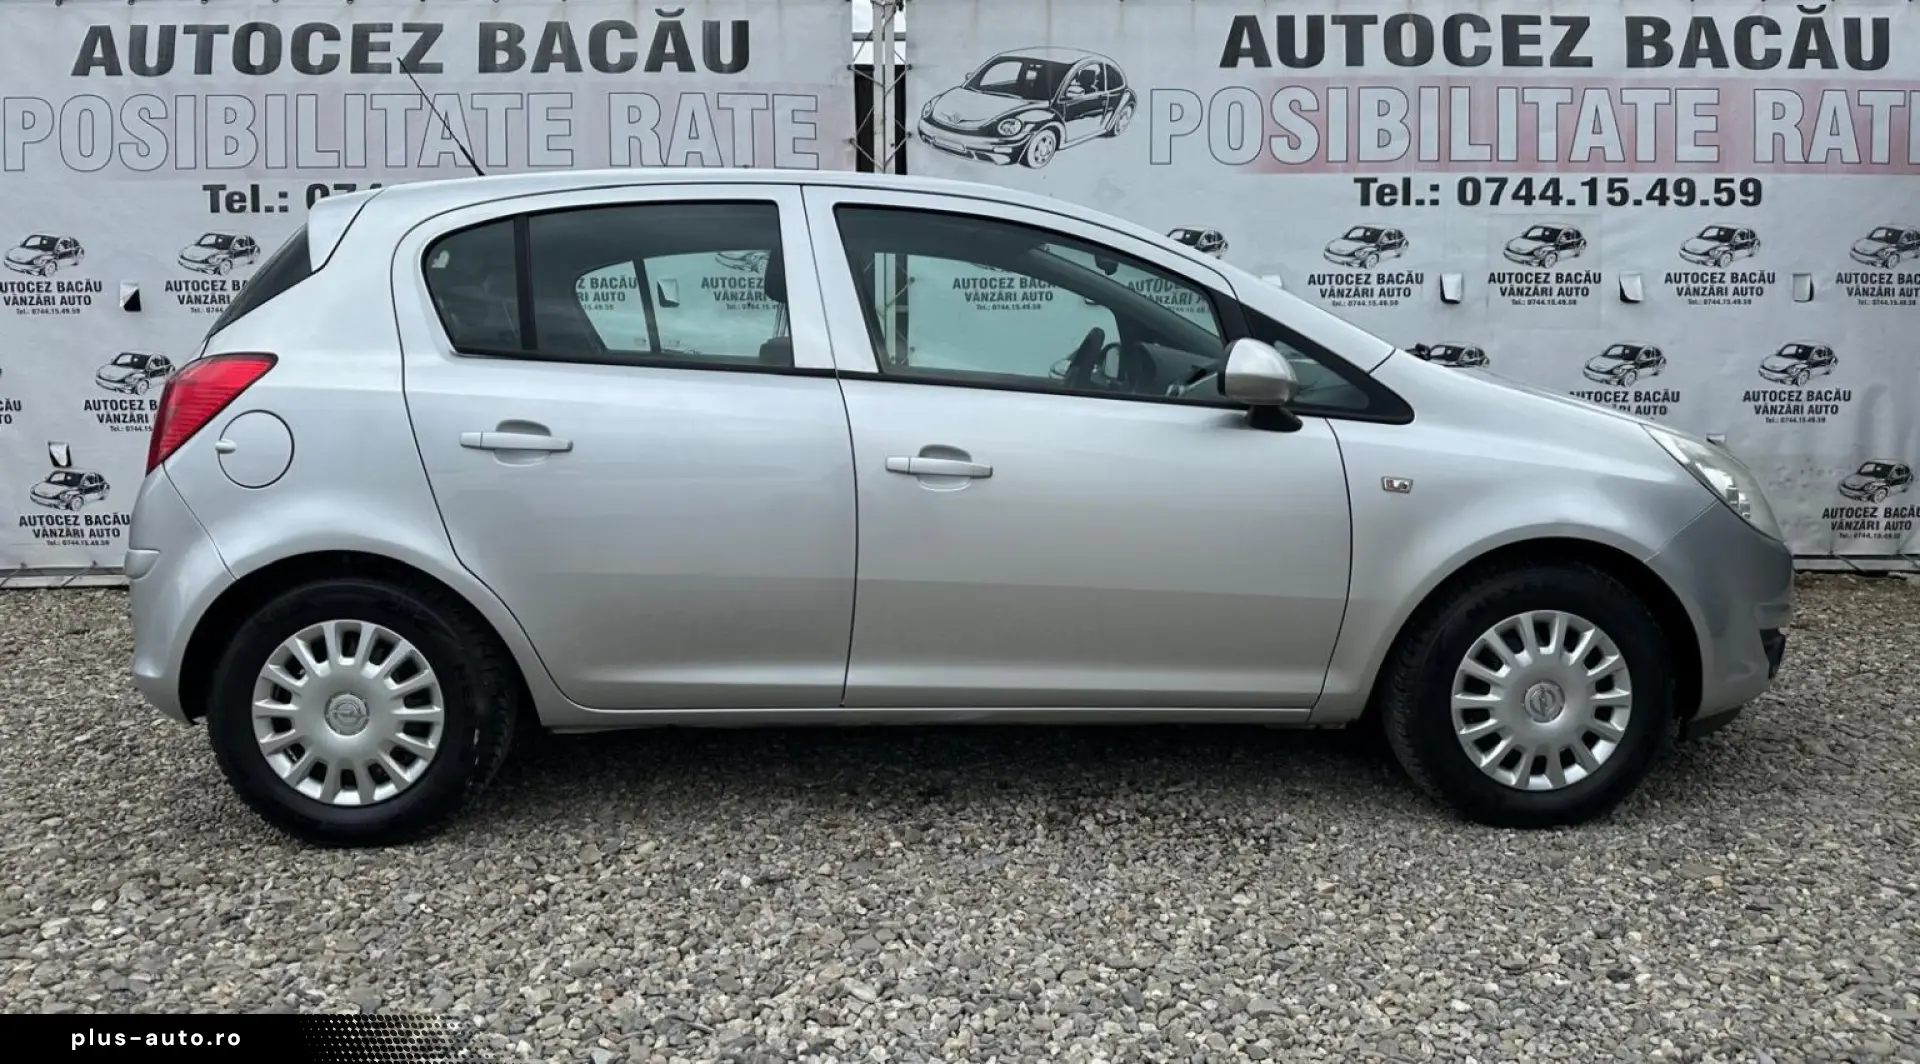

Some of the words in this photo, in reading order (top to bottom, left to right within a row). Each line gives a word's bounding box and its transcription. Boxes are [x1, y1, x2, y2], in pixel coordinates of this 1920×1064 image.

[71, 21, 444, 77] AUTOCEZ
[477, 8, 750, 74] BACĂU
[1219, 13, 1594, 69] AUTOCEZ
[1625, 4, 1890, 71] BACĂU
[3, 92, 575, 172] POSIBILITATE
[608, 92, 820, 171] RATE
[1149, 85, 1720, 166] POSIBILITATE
[1753, 88, 1920, 166] RAT
[202, 183, 289, 213] Tel.:
[1354, 177, 1440, 207] Tel.:
[1457, 176, 1763, 207] 0744.15.49.59
[589, 274, 638, 289] BACĂU
[701, 277, 765, 289] AUTOCEZ
[1307, 273, 1371, 285] AUTOCEZ
[1376, 270, 1424, 285] BACĂU
[1487, 272, 1551, 284] AUTOCEZ
[1555, 270, 1602, 284] BACĂU
[1664, 272, 1726, 284] AUTOCEZ
[1730, 269, 1776, 284] BACĂU
[1834, 272, 1893, 285] AUTOCEZ
[0, 281, 52, 293] UTOCEZ
[56, 278, 102, 293] BACĂU
[165, 279, 227, 292] AUTOCEZ
[952, 277, 1015, 290] AUTOCEZ
[592, 291, 626, 302] AUTO
[1021, 290, 1054, 302] AUTO
[1378, 287, 1412, 298] AUTO
[1557, 286, 1590, 297] AUTO
[1732, 286, 1764, 297] AUTO
[60, 295, 91, 306] AUTO
[1634, 388, 1680, 402] BACĂU
[1742, 390, 1803, 402] AUTOCEZ
[1806, 387, 1852, 402] BACĂU
[84, 399, 145, 411] AUTOCEZ
[1634, 405, 1668, 415] AUTO
[1807, 404, 1839, 415] AUTO
[19, 514, 81, 527] AUTOCEZ
[84, 511, 131, 526] BACĂU
[1821, 506, 1879, 519] AUTOCEZ
[1884, 520, 1912, 531] AUTO
[89, 527, 121, 538] AUTO
